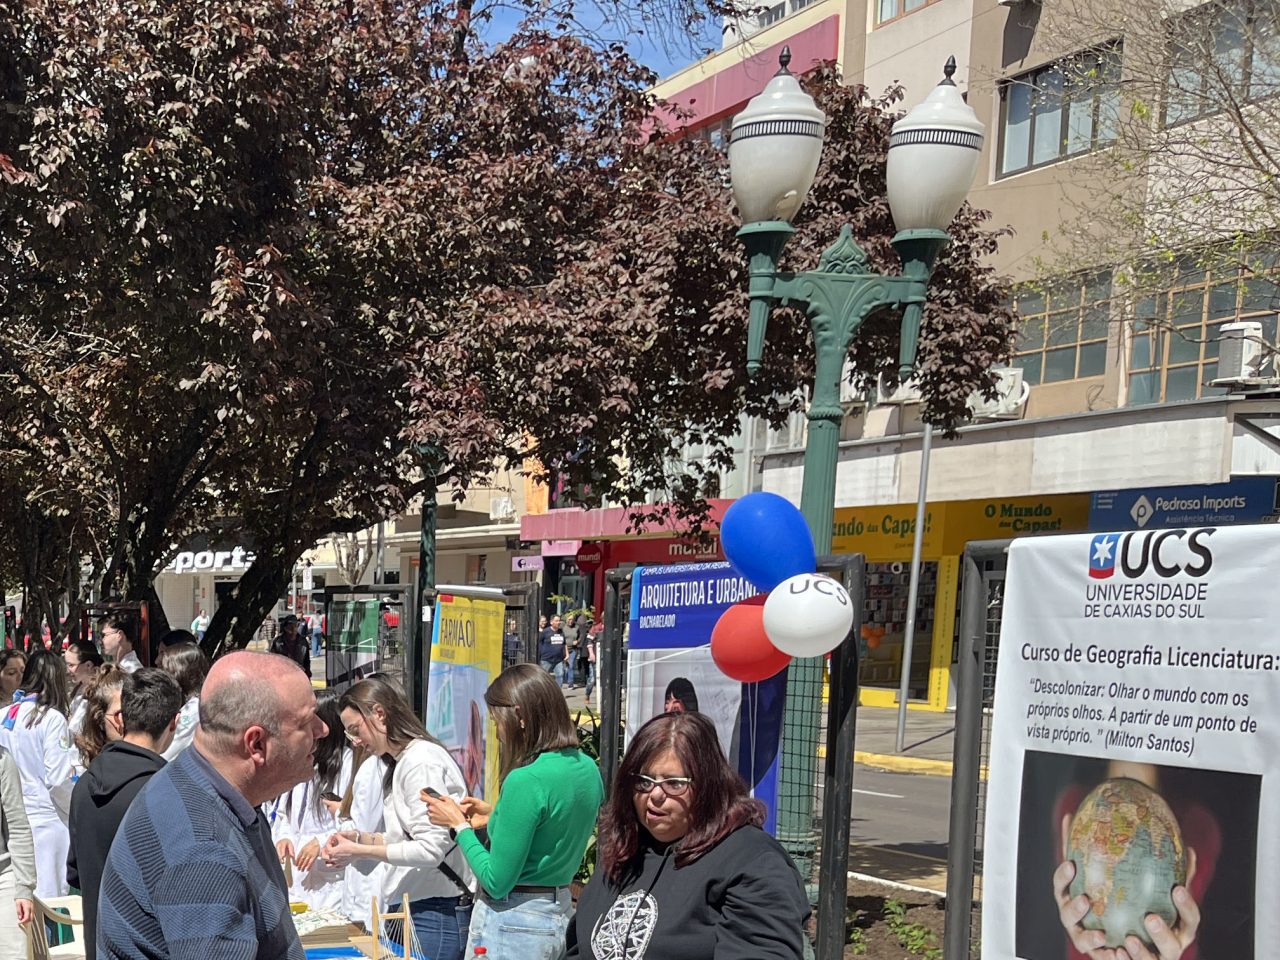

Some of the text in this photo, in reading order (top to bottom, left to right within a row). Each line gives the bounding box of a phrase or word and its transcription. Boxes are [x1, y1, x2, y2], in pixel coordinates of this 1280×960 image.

[984, 503, 1052, 518] O Mundo
[1155, 495, 1246, 512] Pedrosa Imports
[1012, 518, 1062, 532] Capas!
[578, 552, 600, 562] mundi
[1121, 527, 1217, 579] UCS
[641, 566, 663, 577] CAMPUS
[640, 580, 705, 609] ARQUITETURA
[707, 580, 715, 604] E
[789, 578, 849, 606] UCS
[1086, 583, 1209, 601] UNIVERSIDADE
[1084, 604, 1205, 619] DE CAXIAS DO SUL
[639, 614, 675, 629] BACHARELADO
[1021, 643, 1280, 671] Curso de Geografia Licenciatura:
[1108, 682, 1140, 700] Olhar
[1142, 688, 1151, 701] o
[1153, 687, 1197, 703] mundo
[1200, 692, 1229, 706] com
[1232, 693, 1250, 706] os
[1027, 703, 1258, 733] próprios olhos. A partir de um ponto de
[1027, 723, 1050, 740] vista
[1052, 725, 1093, 744] próprio.
[1105, 732, 1143, 750] (Milton
[1146, 735, 1195, 757] Santos)
